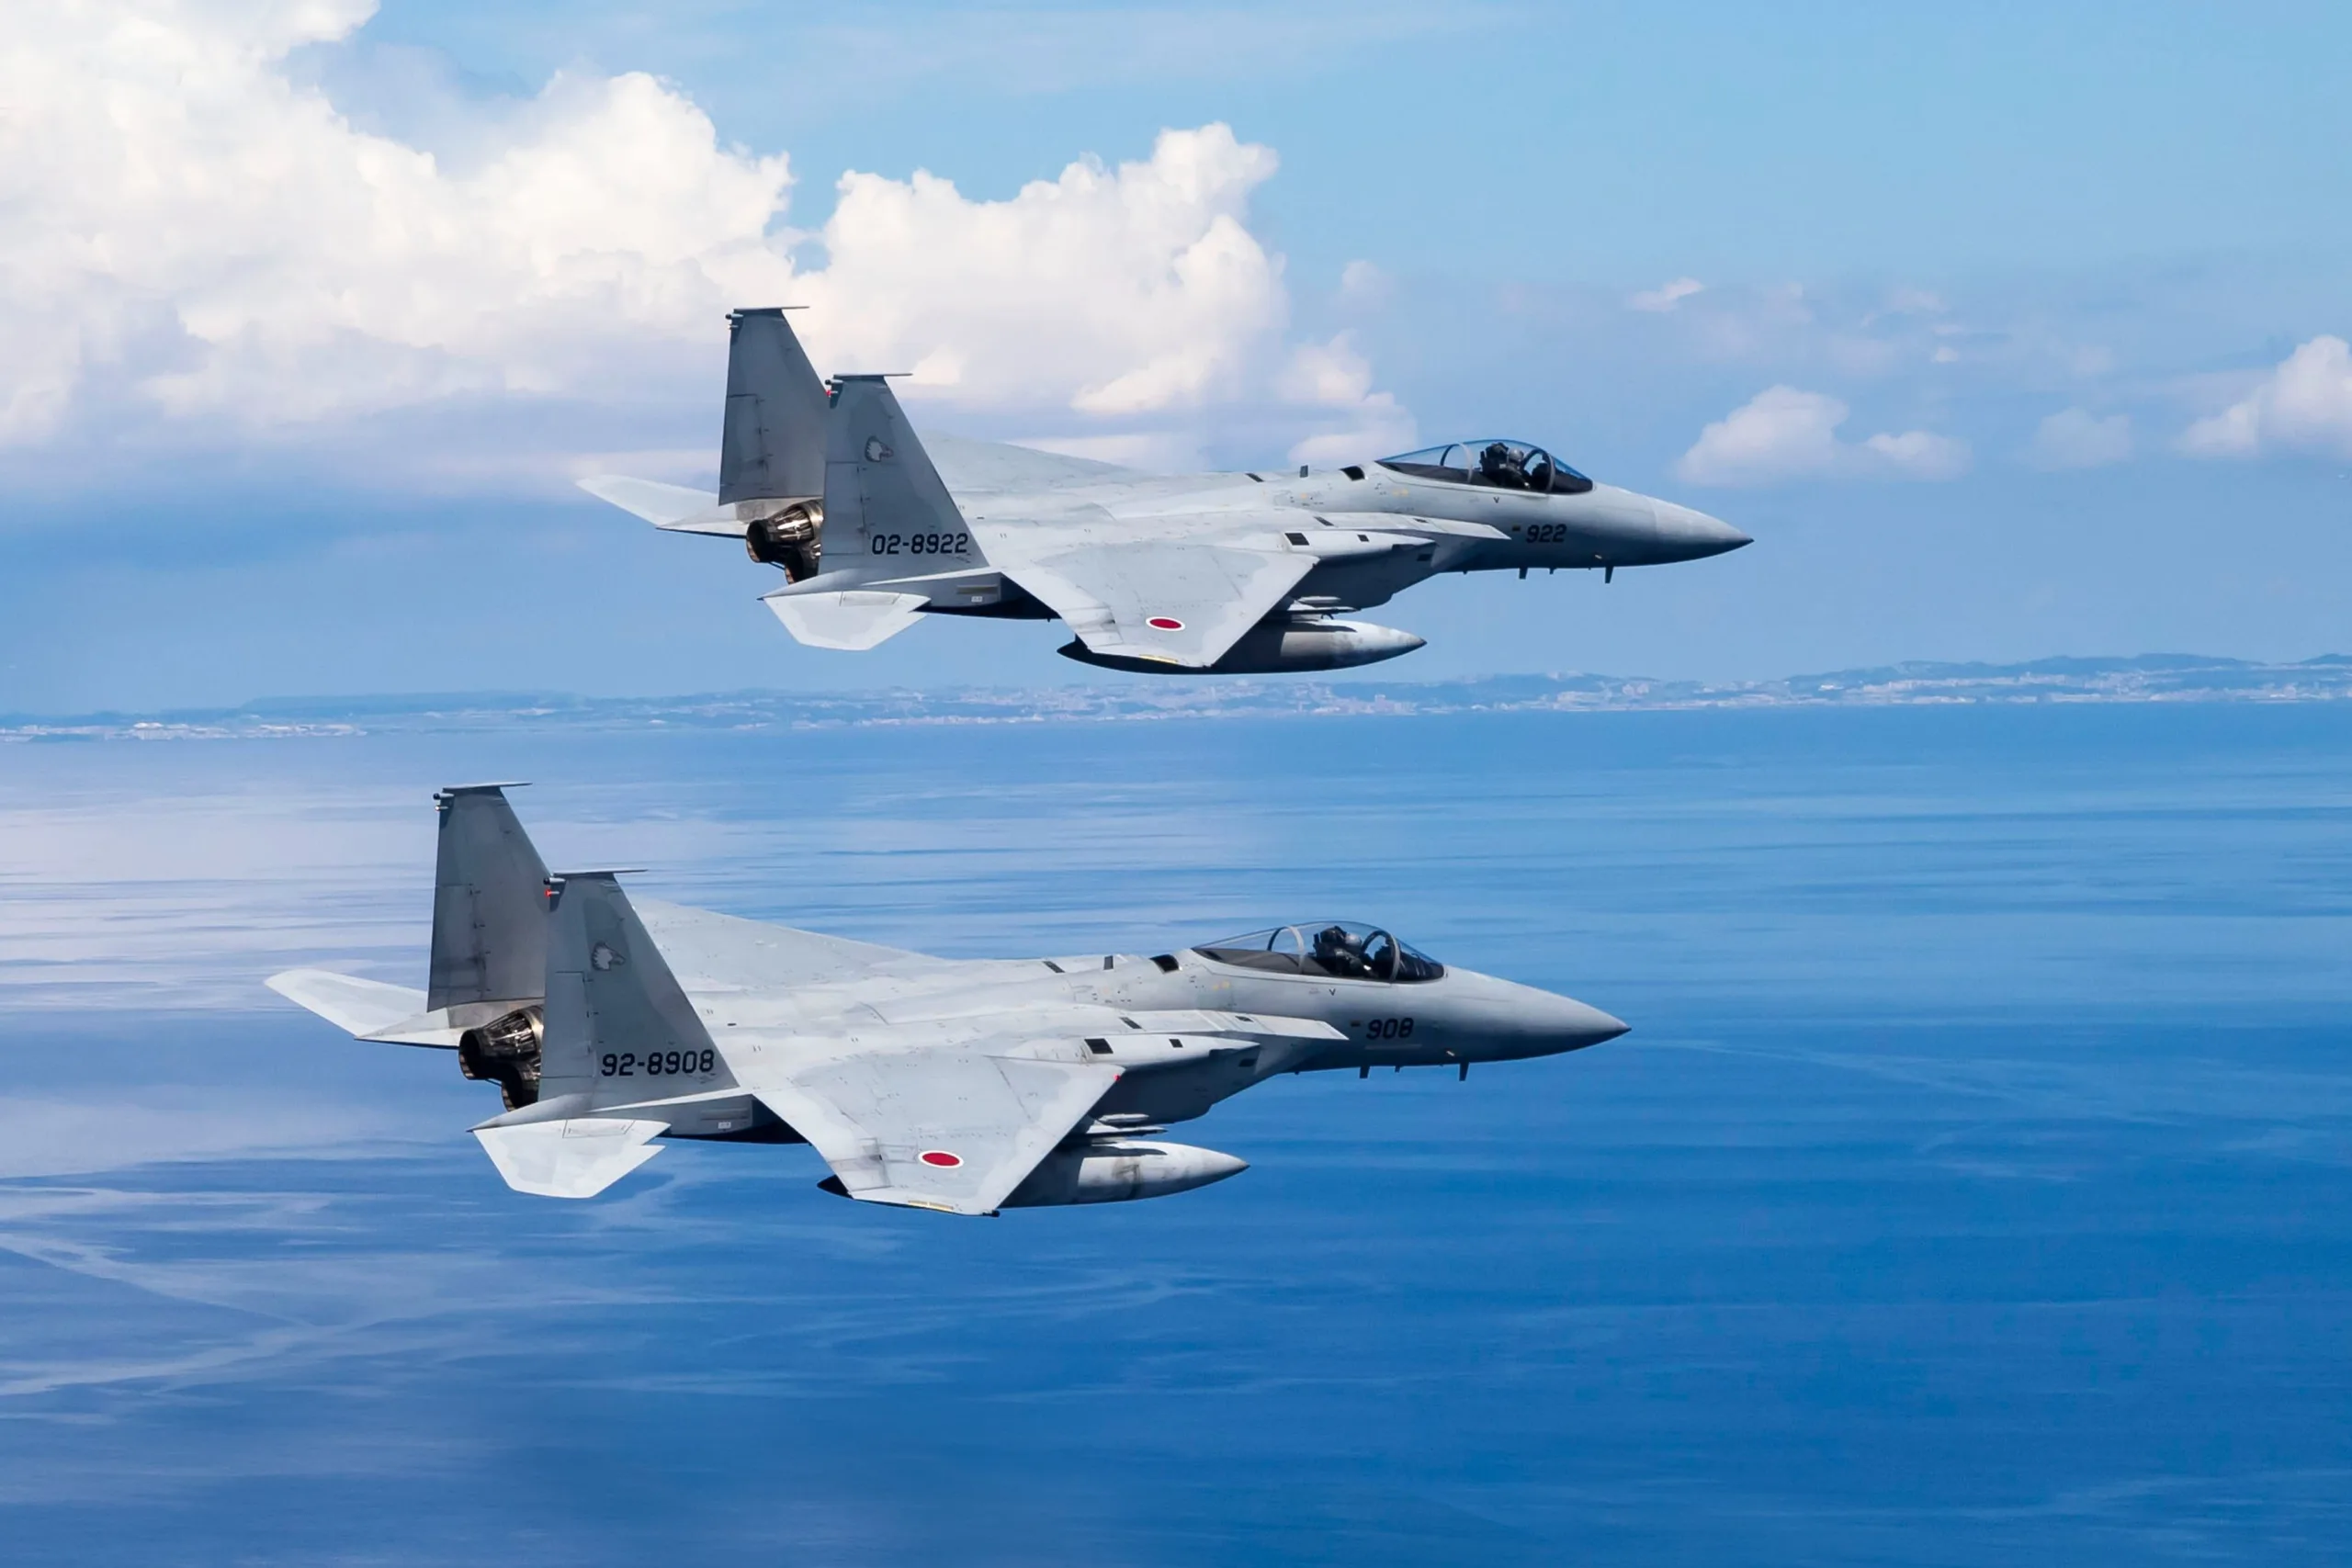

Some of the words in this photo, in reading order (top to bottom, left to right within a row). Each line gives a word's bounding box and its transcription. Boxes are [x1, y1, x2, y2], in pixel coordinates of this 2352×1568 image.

[872, 533, 968, 555] 02-8922
[1526, 524, 1567, 543] 922
[1366, 1017, 1415, 1040] 908
[601, 1049, 715, 1077] 92-8908
